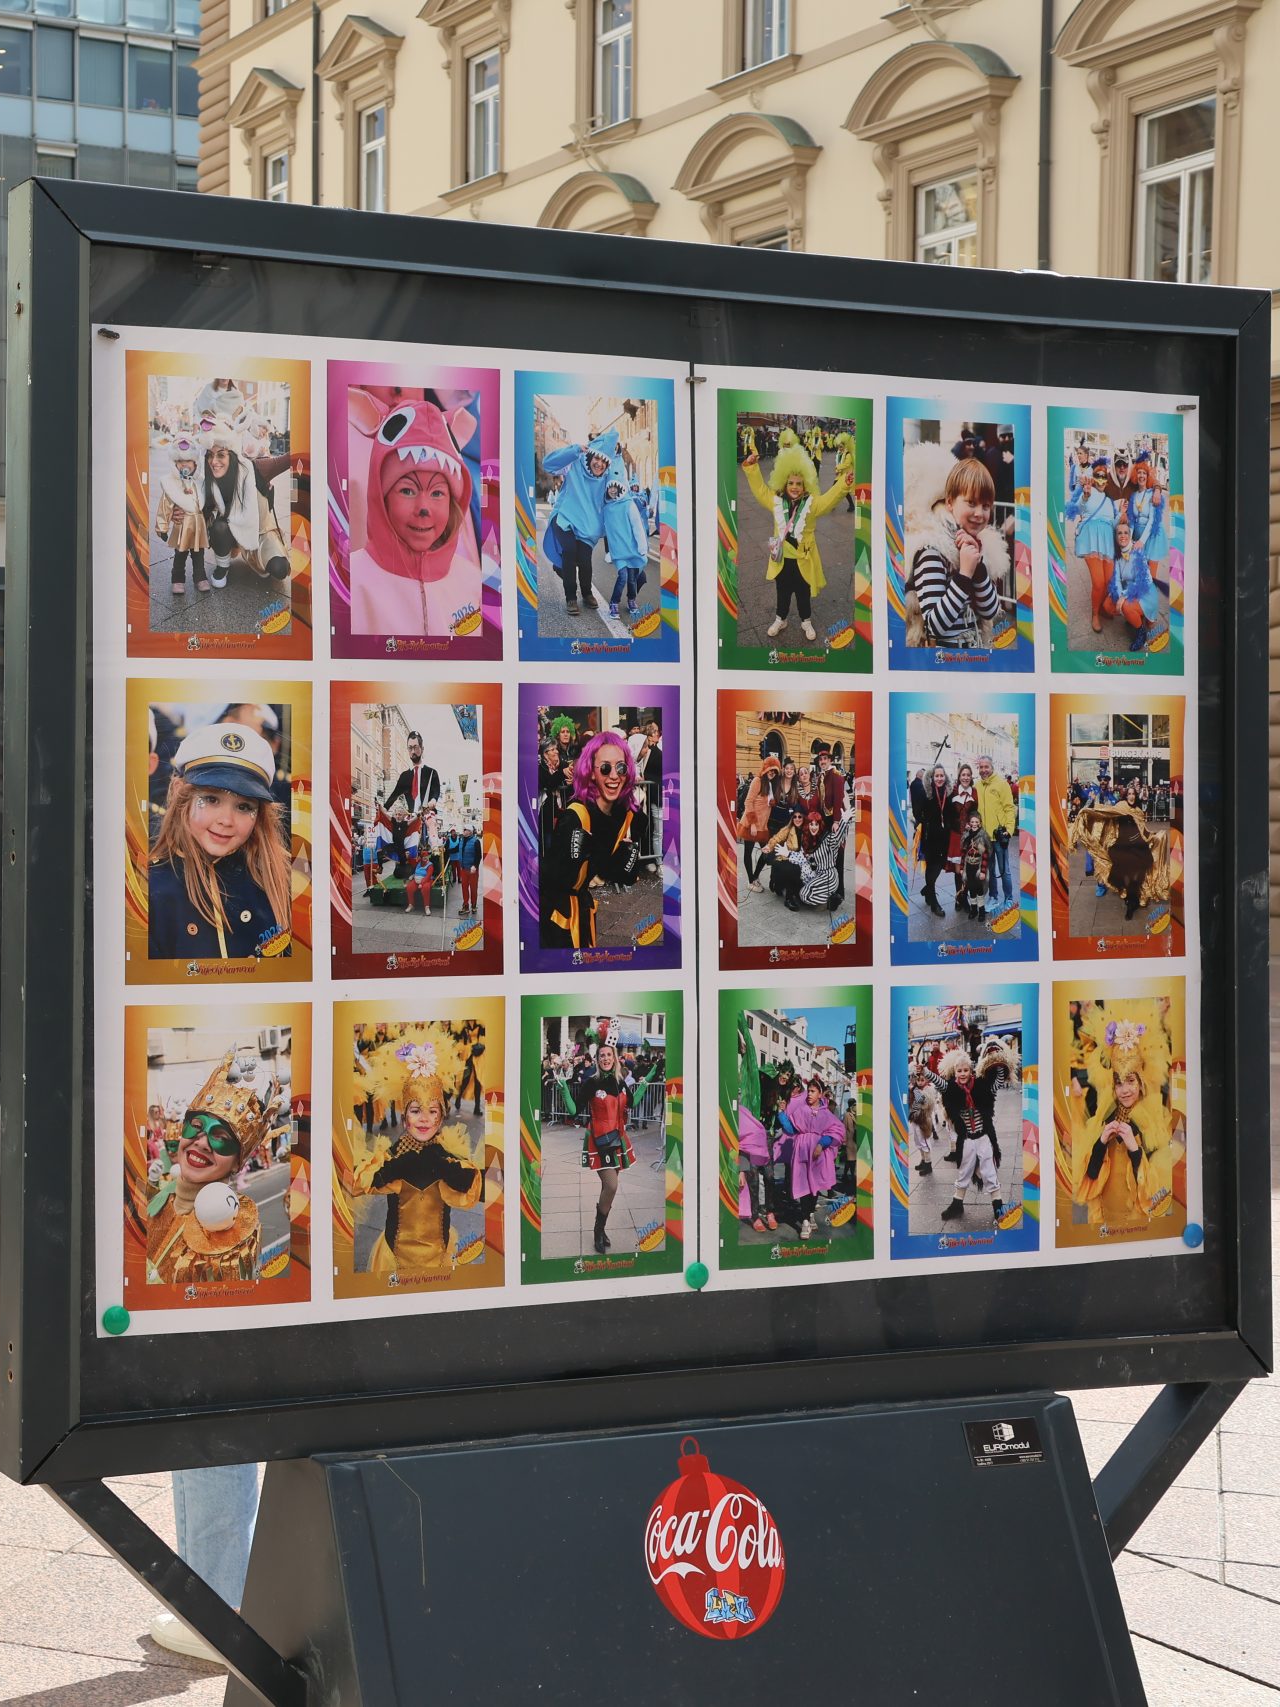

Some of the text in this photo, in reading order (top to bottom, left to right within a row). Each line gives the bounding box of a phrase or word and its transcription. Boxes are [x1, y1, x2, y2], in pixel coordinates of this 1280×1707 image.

[452, 602, 475, 621] 2026
[573, 830, 581, 859] LEKARO
[624, 848, 637, 872] LEKARO
[983, 1441, 1030, 1452] EUROmodul
[645, 1493, 782, 1584] Coca-Cola
